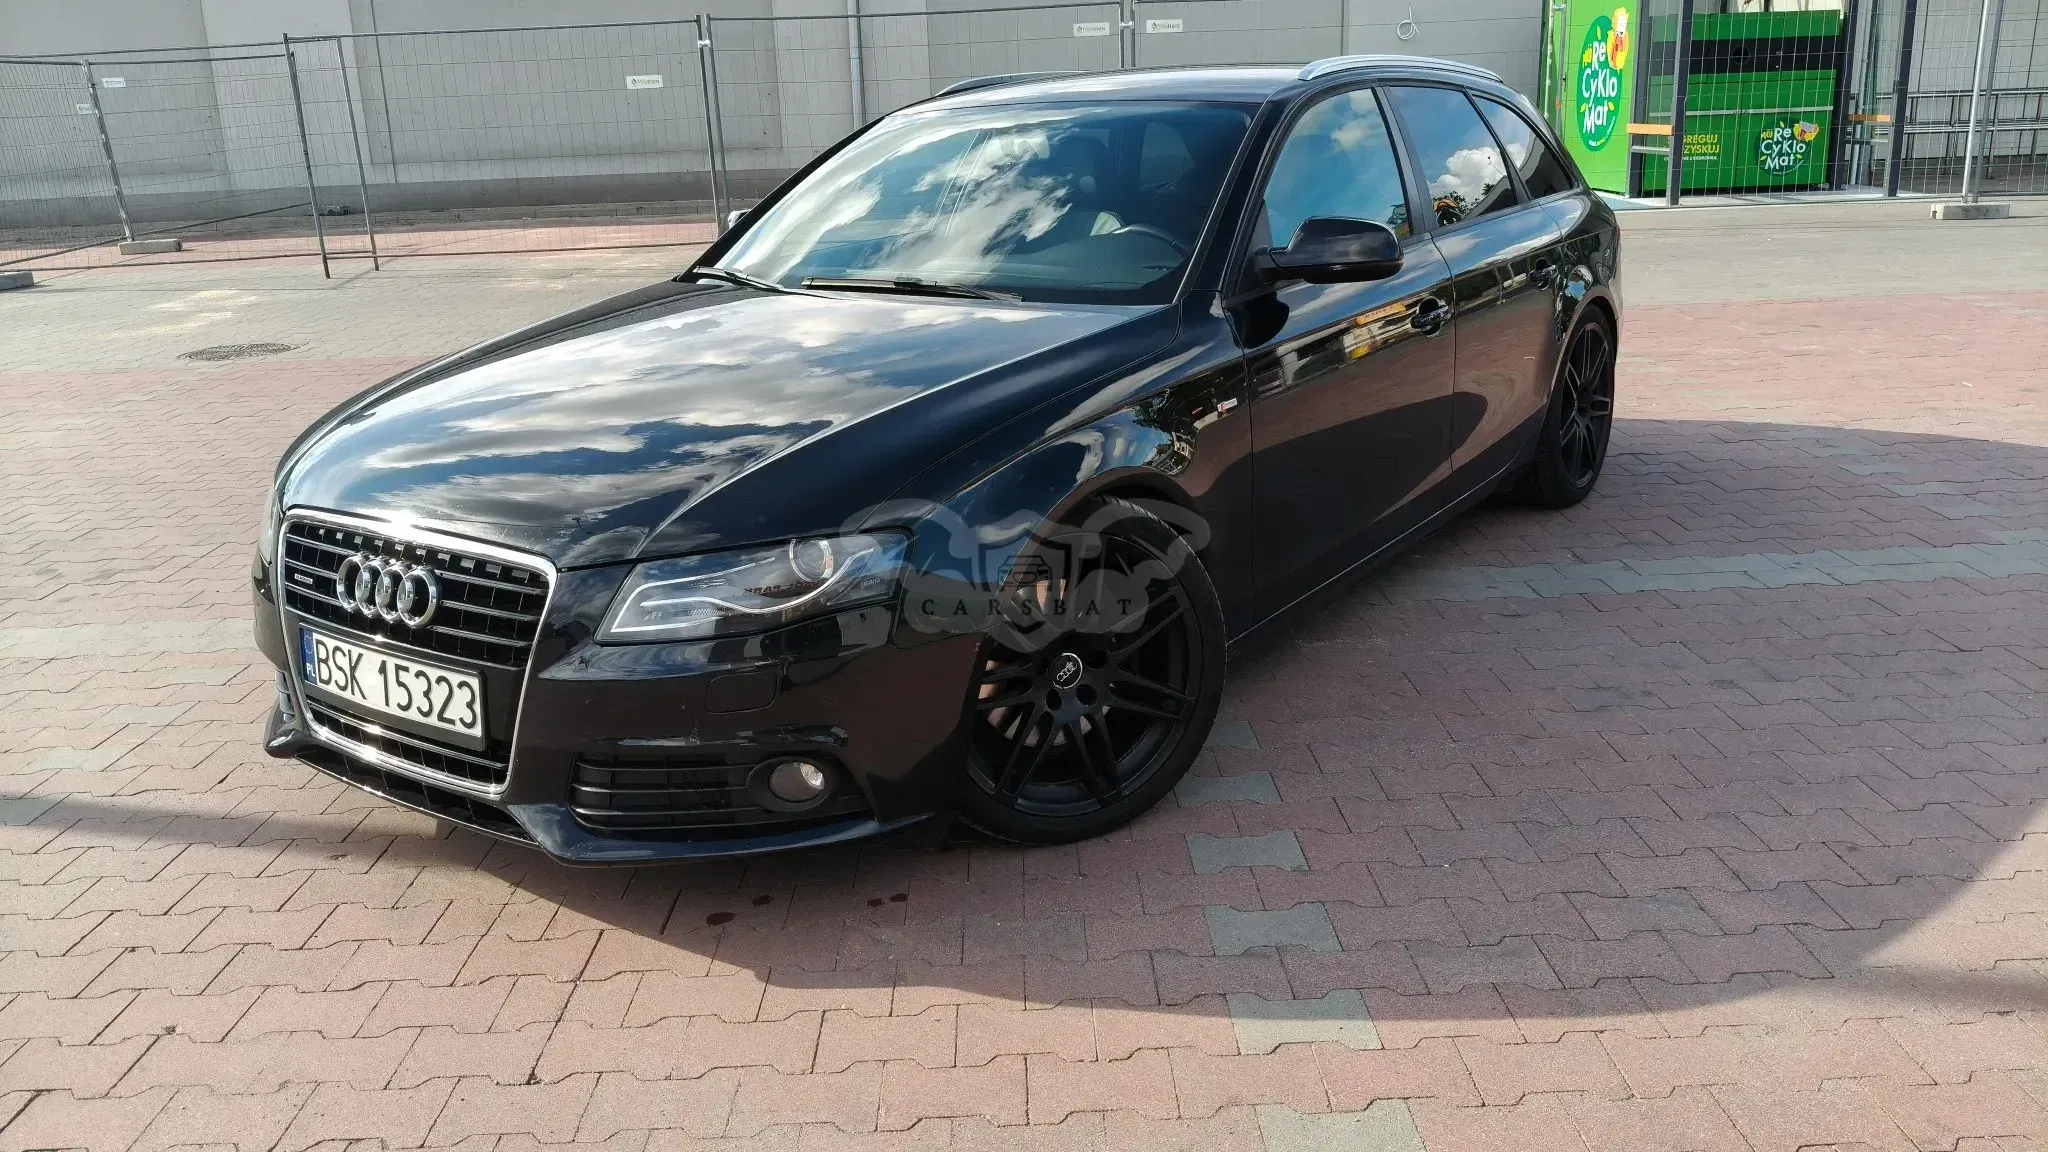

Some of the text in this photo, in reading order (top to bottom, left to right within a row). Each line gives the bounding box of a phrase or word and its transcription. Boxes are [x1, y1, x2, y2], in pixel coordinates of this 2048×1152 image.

[1592, 41, 1606, 71] Re
[1582, 68, 1617, 107] CyKlo
[1583, 100, 1608, 133] Mat
[1773, 127, 1792, 141] Re
[1761, 140, 1806, 158] CyKlo
[1765, 153, 1795, 169] Mat
[306, 662, 316, 677] PL
[315, 638, 477, 729] BSK 15323
